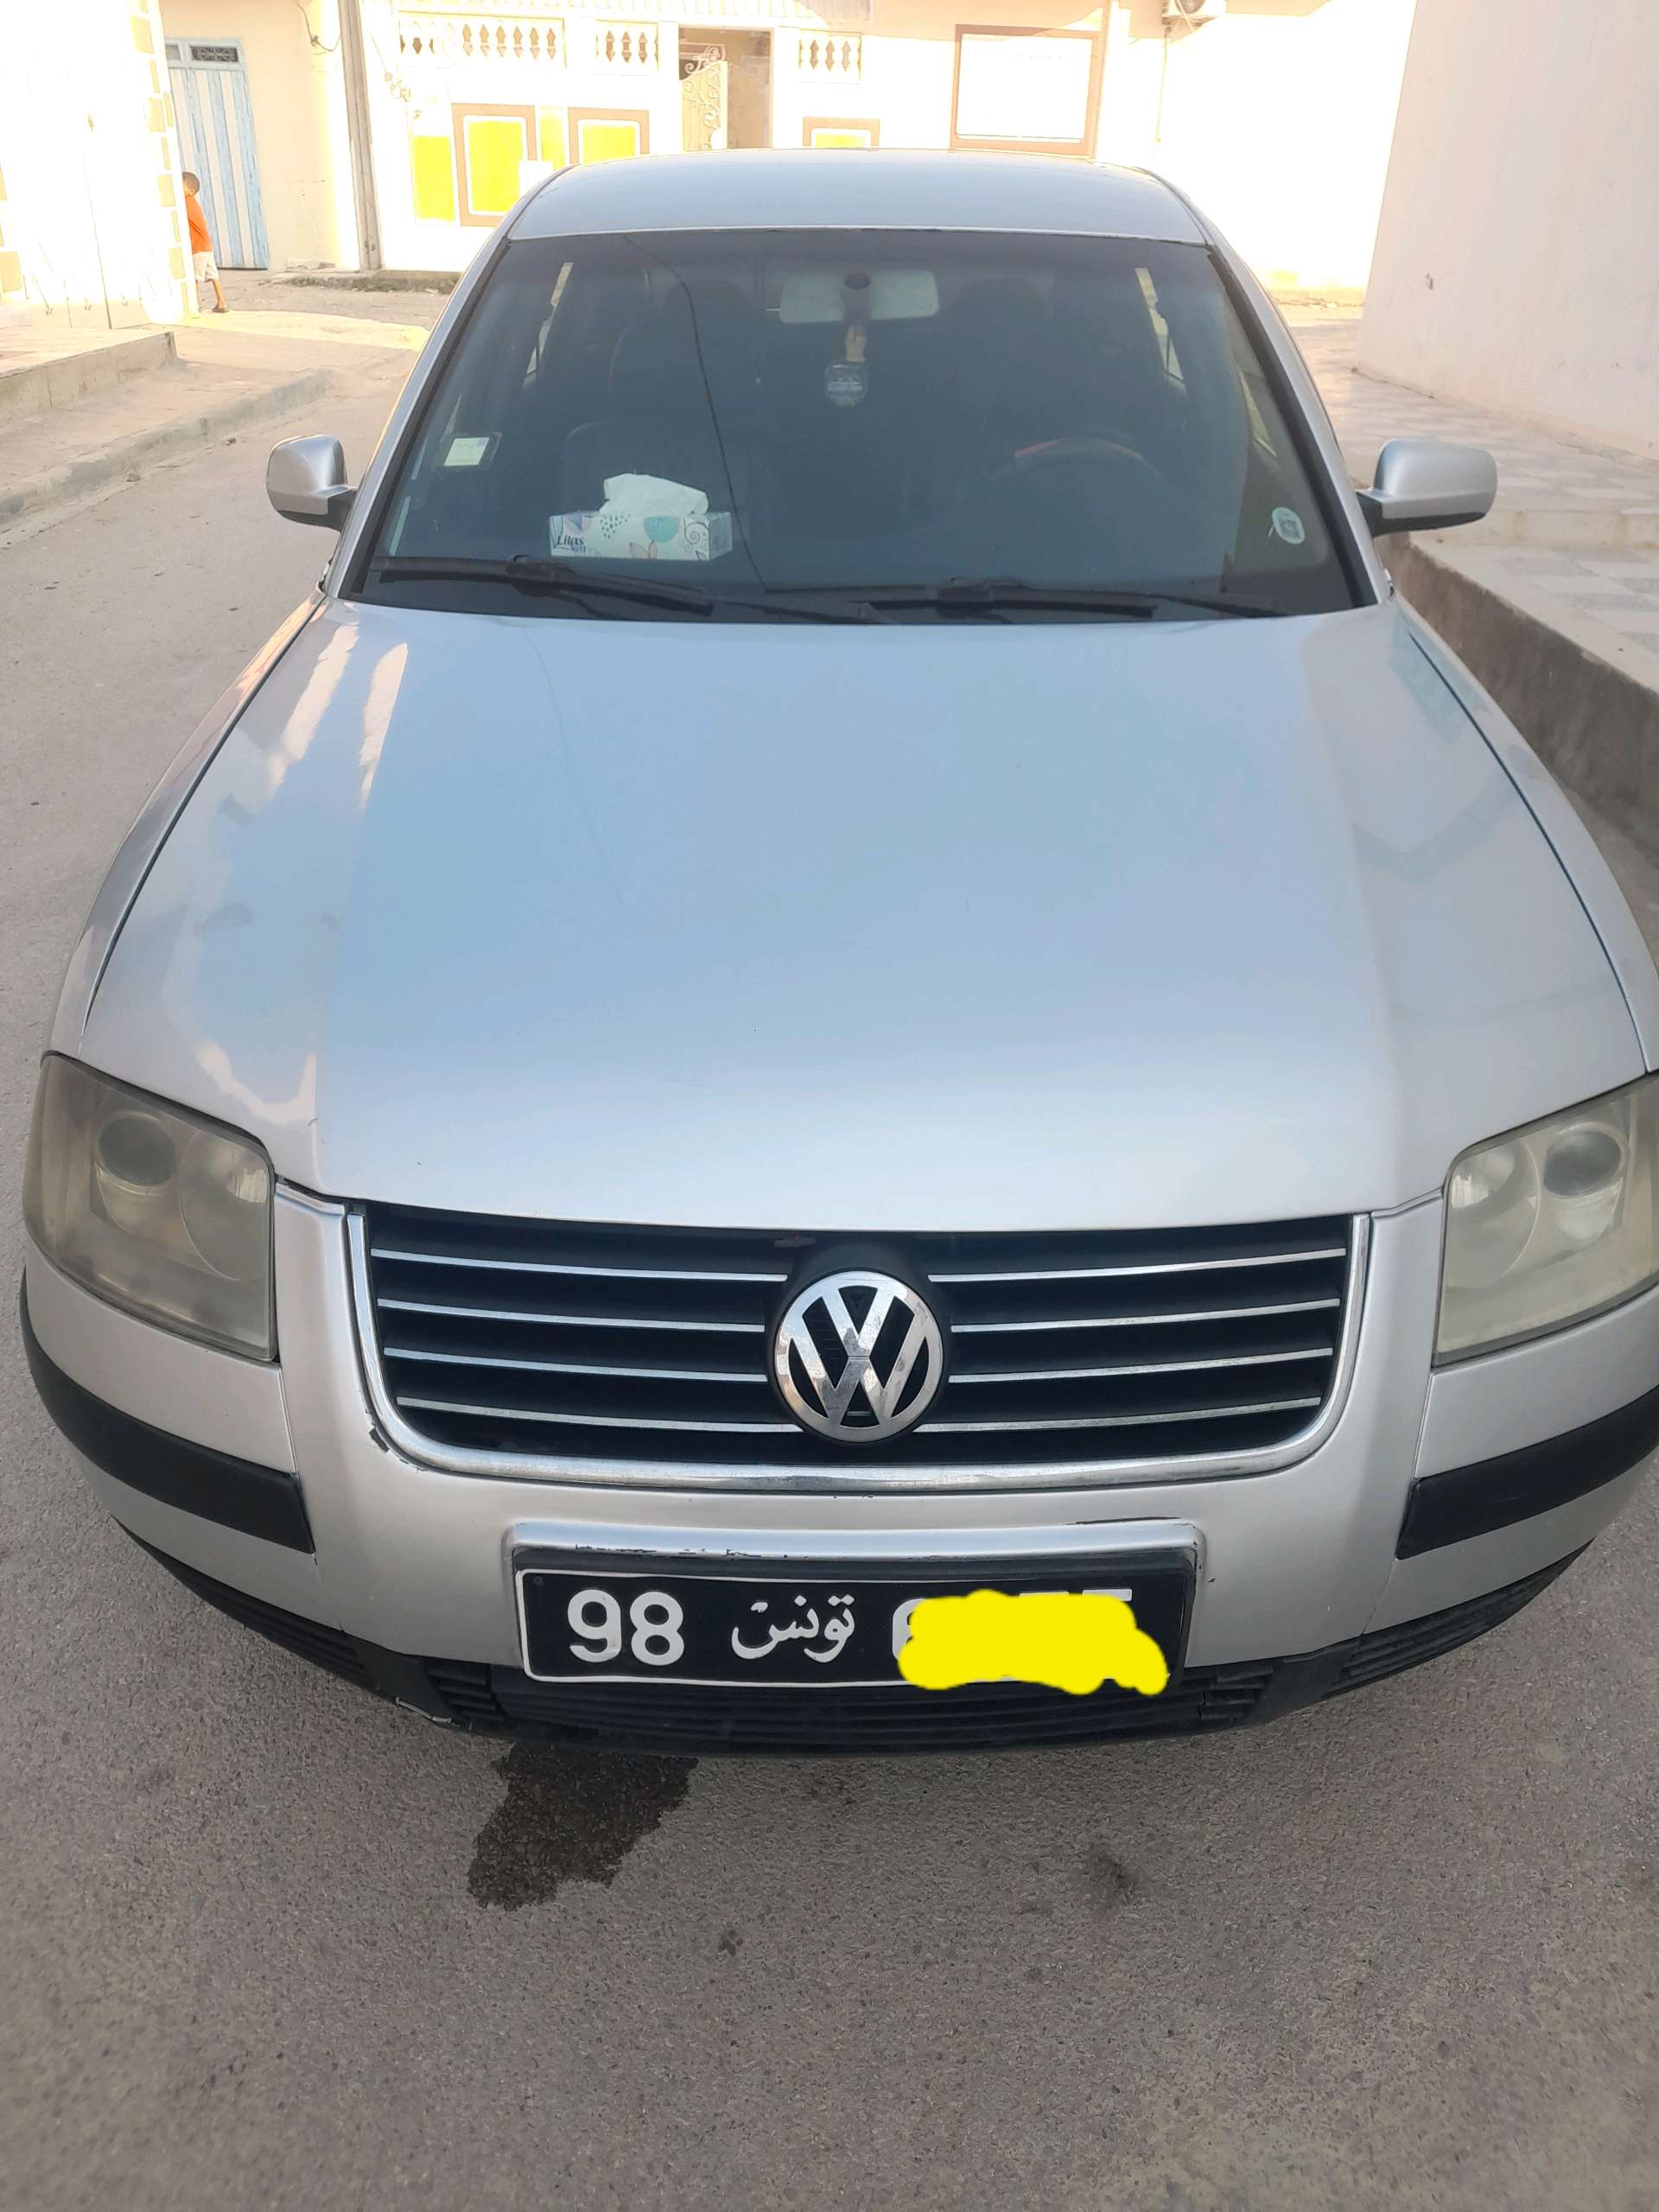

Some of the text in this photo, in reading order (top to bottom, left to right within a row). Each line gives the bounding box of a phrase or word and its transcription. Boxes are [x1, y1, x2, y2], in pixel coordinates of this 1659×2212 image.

[556, 533, 585, 545] Lilas
[774, 1270, 944, 1442] VW
[567, 1588, 684, 1666] 98
[731, 1594, 855, 1663] تونس
